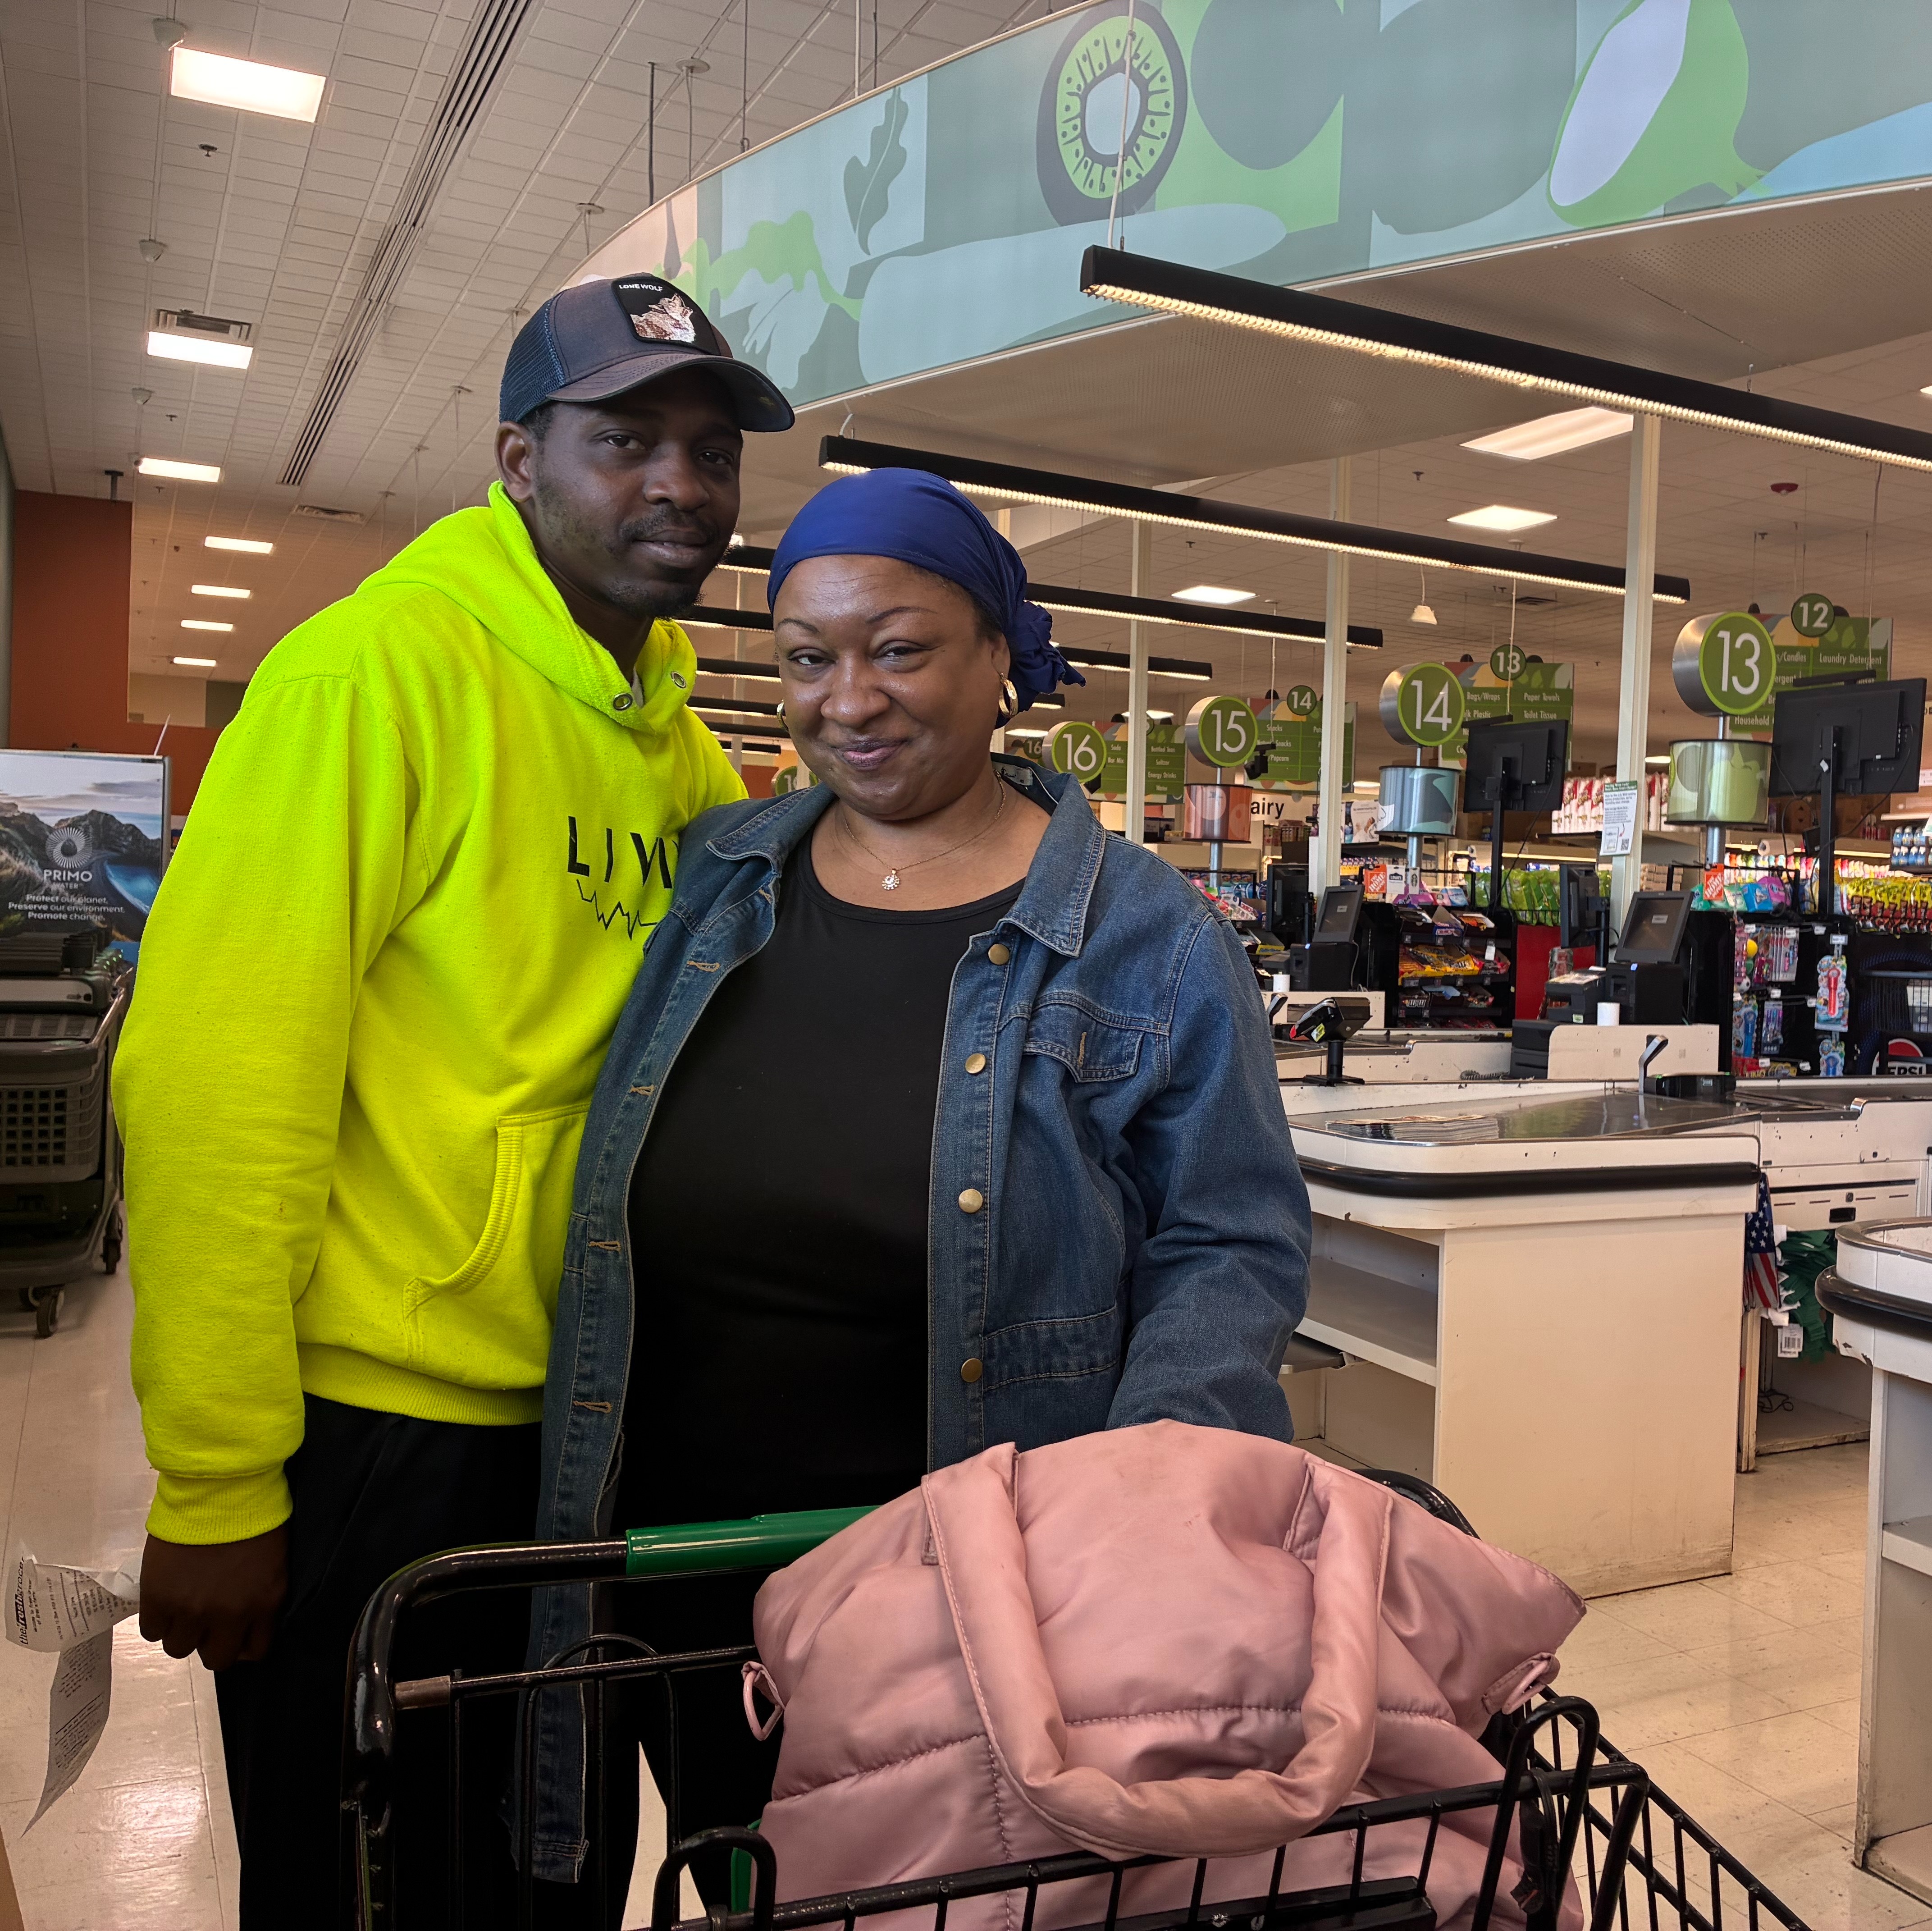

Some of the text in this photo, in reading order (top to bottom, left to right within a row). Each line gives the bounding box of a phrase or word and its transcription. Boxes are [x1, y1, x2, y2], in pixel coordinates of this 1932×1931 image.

[1800, 602, 1828, 628] 12
[1497, 652, 1521, 673] 13
[1717, 630, 1760, 695] 13
[1819, 652, 1846, 665] Laundry
[1292, 691, 1312, 709] 14
[1524, 692, 1560, 702] Paper Towels
[1411, 680, 1452, 731] 14
[1524, 710, 1557, 719] Toilet Tissue
[1735, 715, 1769, 726] Household
[1211, 709, 1247, 753] 15
[1028, 741, 1041, 754] 16
[1062, 734, 1096, 771] 16
[1268, 754, 1289, 762] /Popcorn
[1250, 797, 1284, 819] airy
[44, 869, 92, 882] PRIMO
[26, 894, 59, 902] Protect
[8, 901, 48, 911] Preserve
[28, 911, 68, 920] Promote
